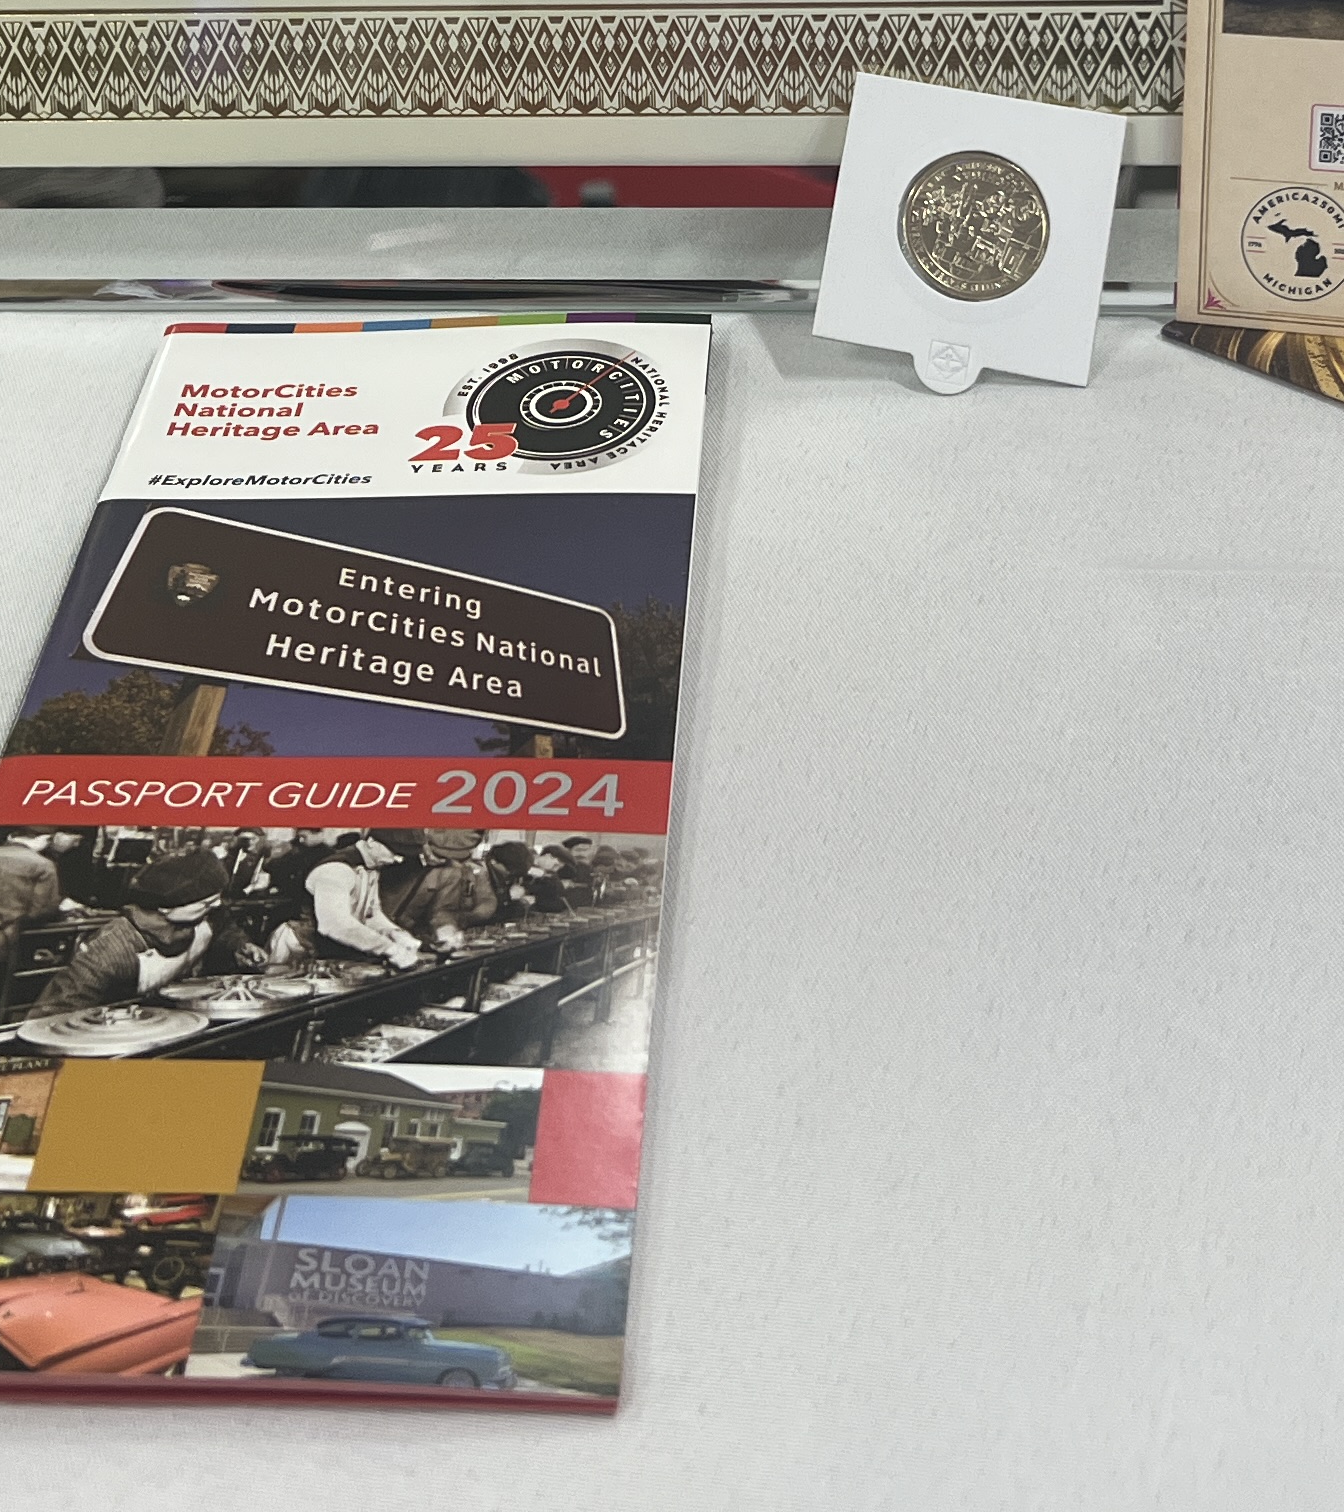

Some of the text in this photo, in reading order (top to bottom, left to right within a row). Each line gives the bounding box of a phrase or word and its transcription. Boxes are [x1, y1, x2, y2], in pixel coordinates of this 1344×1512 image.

[1253, 192, 1344, 229] AMERICA250MI
[1263, 273, 1332, 295] MICHIGAN
[181, 383, 358, 399] MotorCities
[457, 376, 483, 398] EST.
[506, 360, 640, 438] MOTORCITIES
[173, 402, 303, 418] National
[549, 356, 671, 471] NATIONAL HERITAGE AREA
[166, 420, 379, 440] Heritage Area
[408, 422, 519, 462] 25
[148, 473, 372, 488] #ExploreMotorCities
[410, 461, 508, 474] YEARS
[338, 567, 483, 620] Entering
[248, 587, 603, 678] MotorCities National
[264, 633, 524, 699] Heritage Area
[18, 770, 624, 817] PASSPORT GUIDE 2024
[12, 1059, 50, 1071] PLANT
[294, 1246, 430, 1281] SLOAN
[289, 1270, 429, 1297] MUSEUM
[318, 1292, 425, 1308] DISCOVERY
